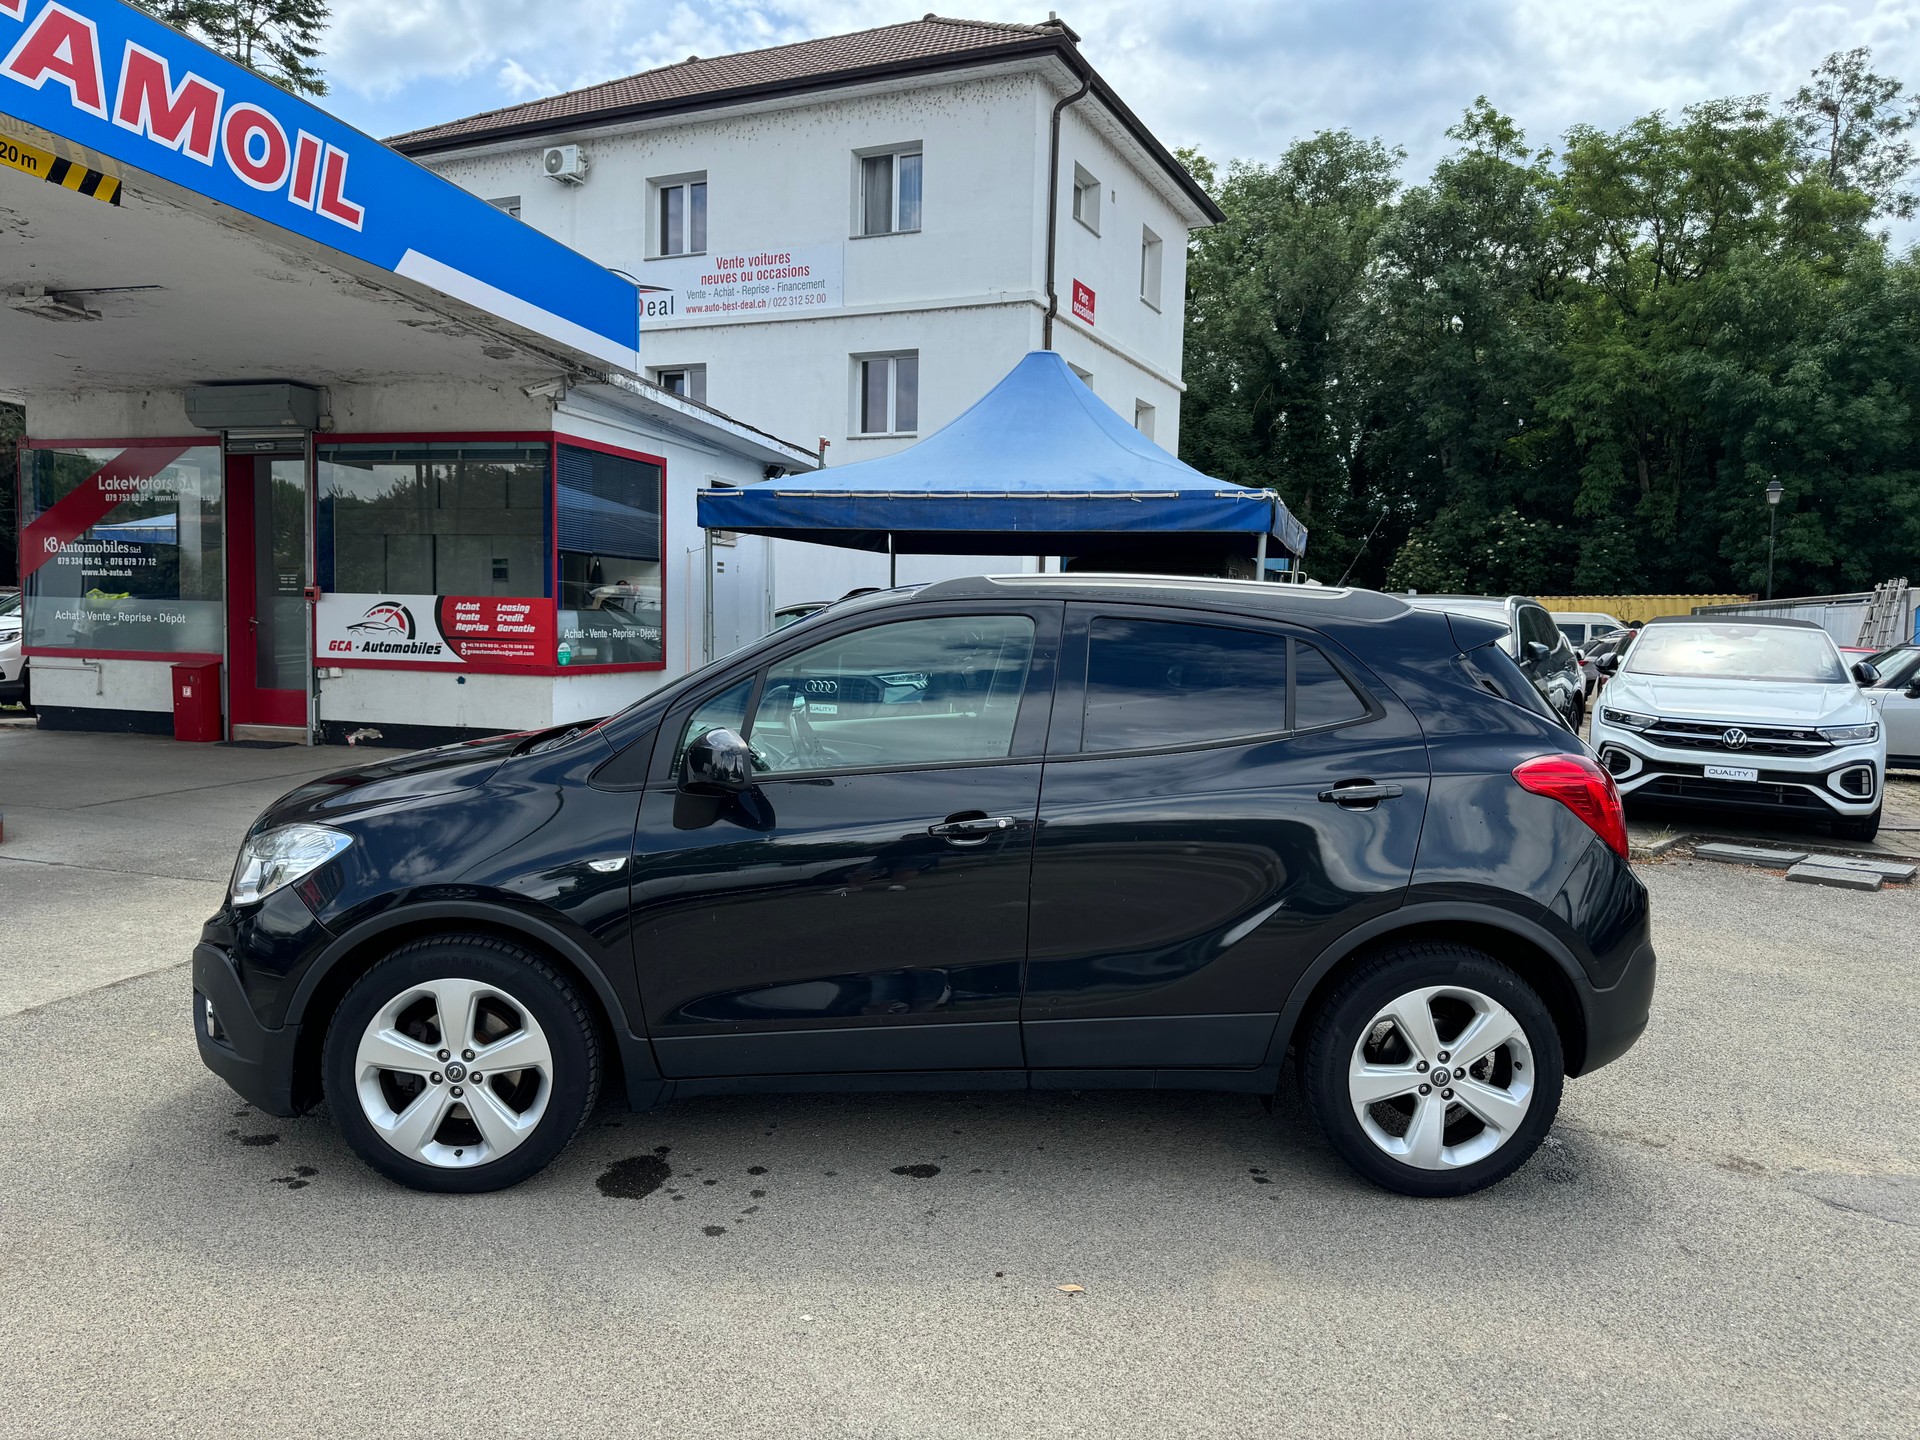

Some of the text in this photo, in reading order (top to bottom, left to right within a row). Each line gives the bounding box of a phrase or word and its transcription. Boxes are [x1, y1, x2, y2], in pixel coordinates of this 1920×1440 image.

[0, 0, 365, 232] AMOIL
[21, 153, 37, 170] m
[716, 253, 791, 270] Vente voitures
[701, 265, 809, 285] neuves ou occasions
[686, 290, 706, 299] Vente
[713, 287, 734, 298] Achat
[741, 284, 769, 296] Reprise
[777, 279, 825, 292] Financement
[686, 299, 766, 313] www.auto-best-deal.ch
[773, 296, 787, 307] 022
[789, 295, 803, 306] 312
[805, 294, 815, 305] 52
[816, 293, 826, 303] 00
[58, 540, 129, 553] Automobiles
[57, 557, 69, 565] 079
[70, 557, 83, 565] 334
[84, 557, 93, 565] 65
[110, 557, 123, 566] 076
[124, 558, 137, 566] 679
[137, 558, 146, 566] 77
[148, 558, 157, 566] 12
[455, 602, 530, 613] Achat Leasing
[54, 610, 80, 620] Achat
[86, 611, 111, 621] Vente
[118, 612, 152, 623] Reprise
[159, 613, 186, 625] Dépôt
[455, 612, 524, 622] Vente Credit
[455, 622, 535, 633] Reprise Garantie
[564, 629, 584, 639] Achat
[589, 628, 608, 638] Vente
[612, 628, 636, 640] Reprise
[328, 640, 352, 652] GCA
[361, 641, 442, 655] Automobiles
[1708, 768, 1749, 777] QUALITY
